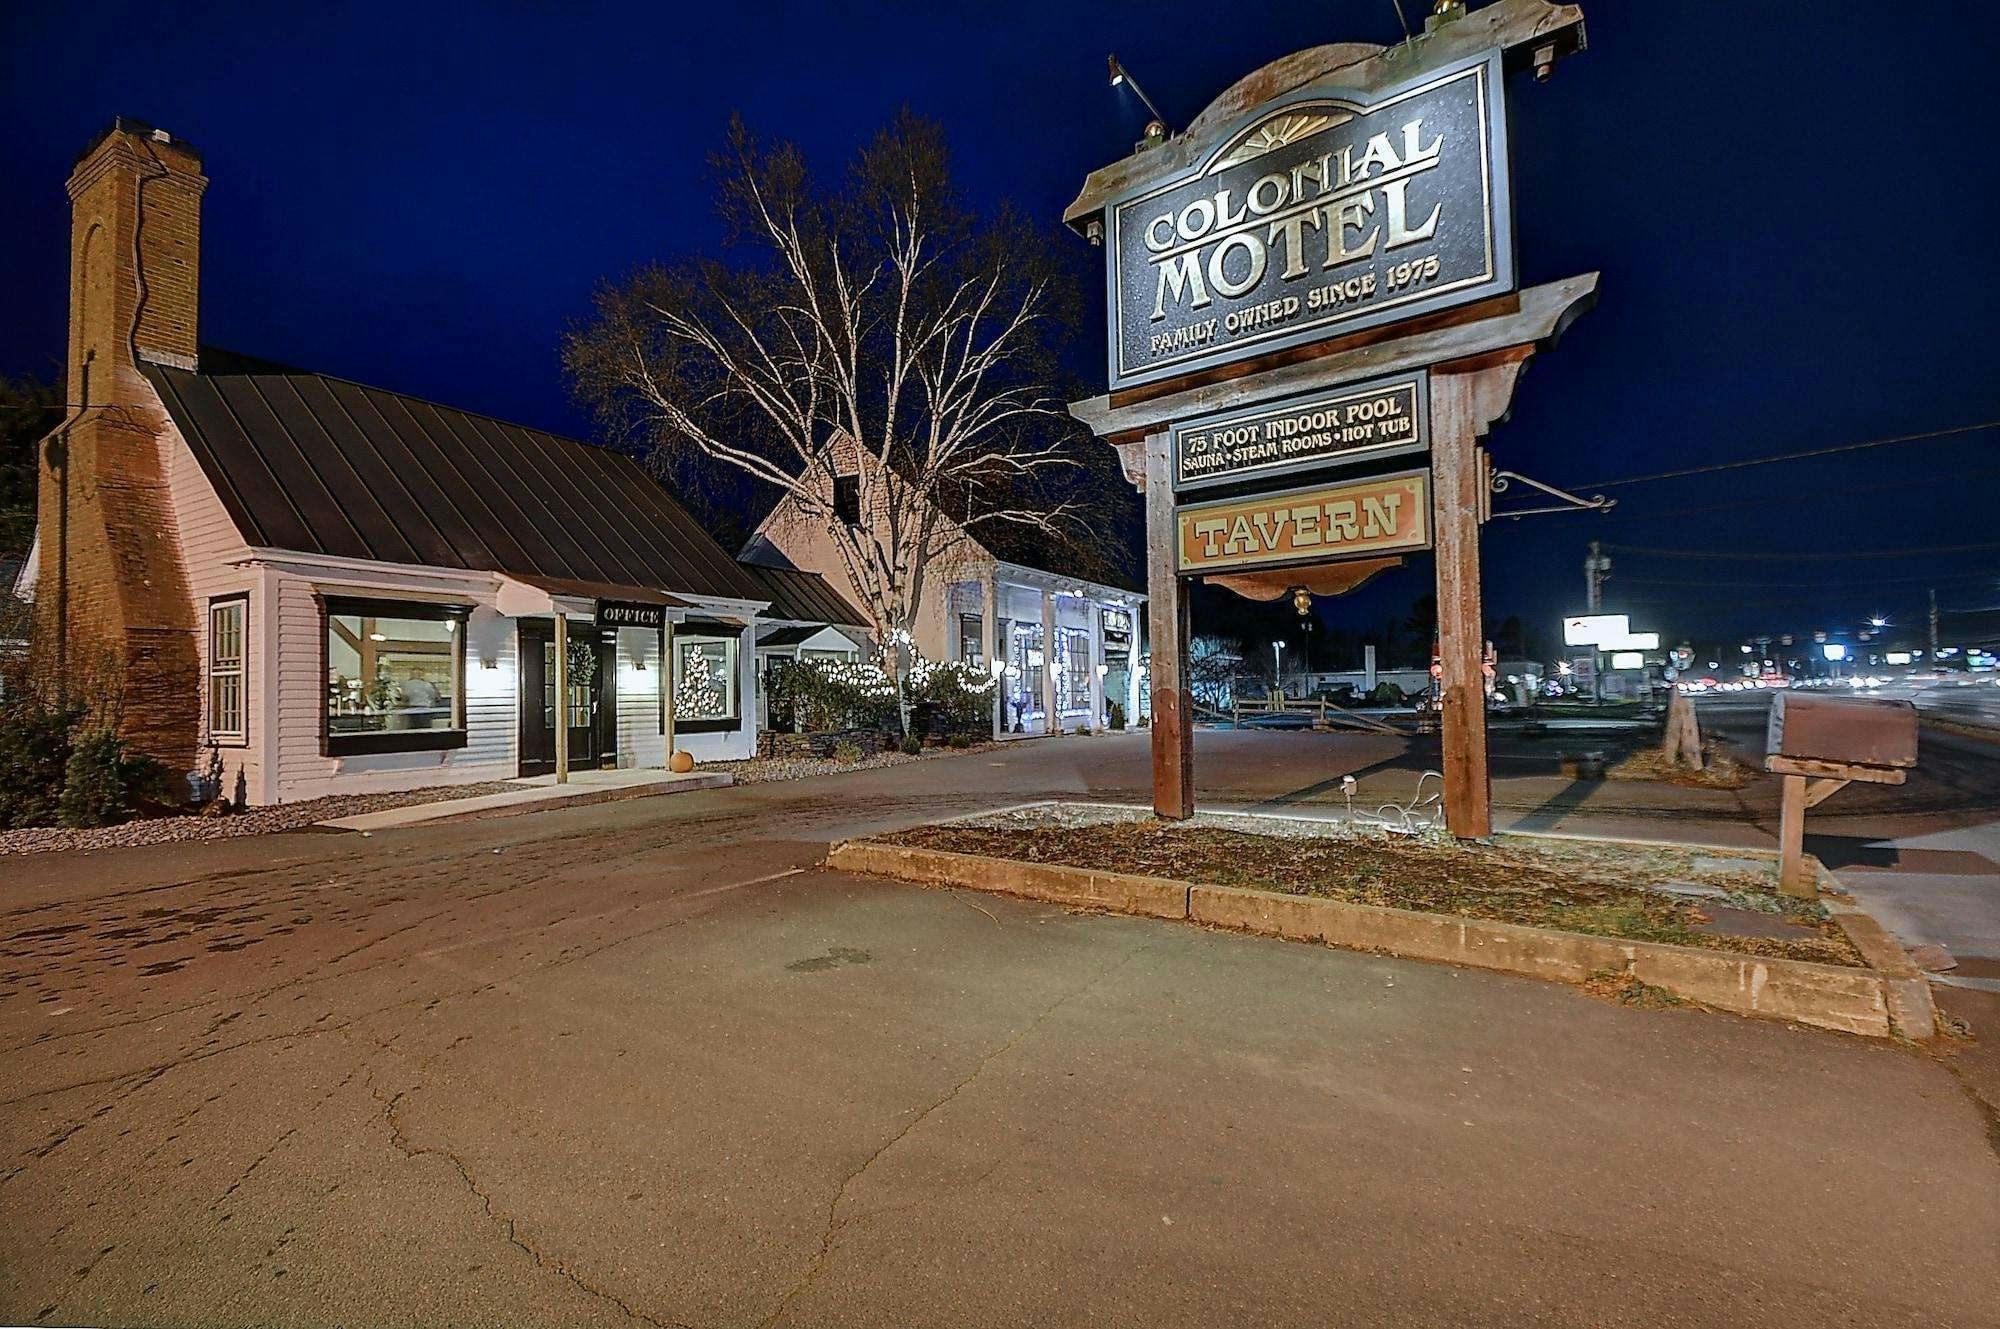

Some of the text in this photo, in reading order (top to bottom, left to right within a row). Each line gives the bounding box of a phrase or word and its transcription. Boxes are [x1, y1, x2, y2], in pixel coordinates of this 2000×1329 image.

[1144, 118, 1445, 253] COLONIAL
[1149, 177, 1442, 322] MOTEL
[1150, 255, 1440, 353] FAMILY OWNED SINCE 1975
[1183, 416, 1410, 472] SAUNA STEAM ROOMS HOT TUB
[1188, 397, 1402, 454] 75 FOOT INDOOR POOL
[1195, 494, 1401, 558] TAVERN
[604, 608, 660, 624] OFFICE
